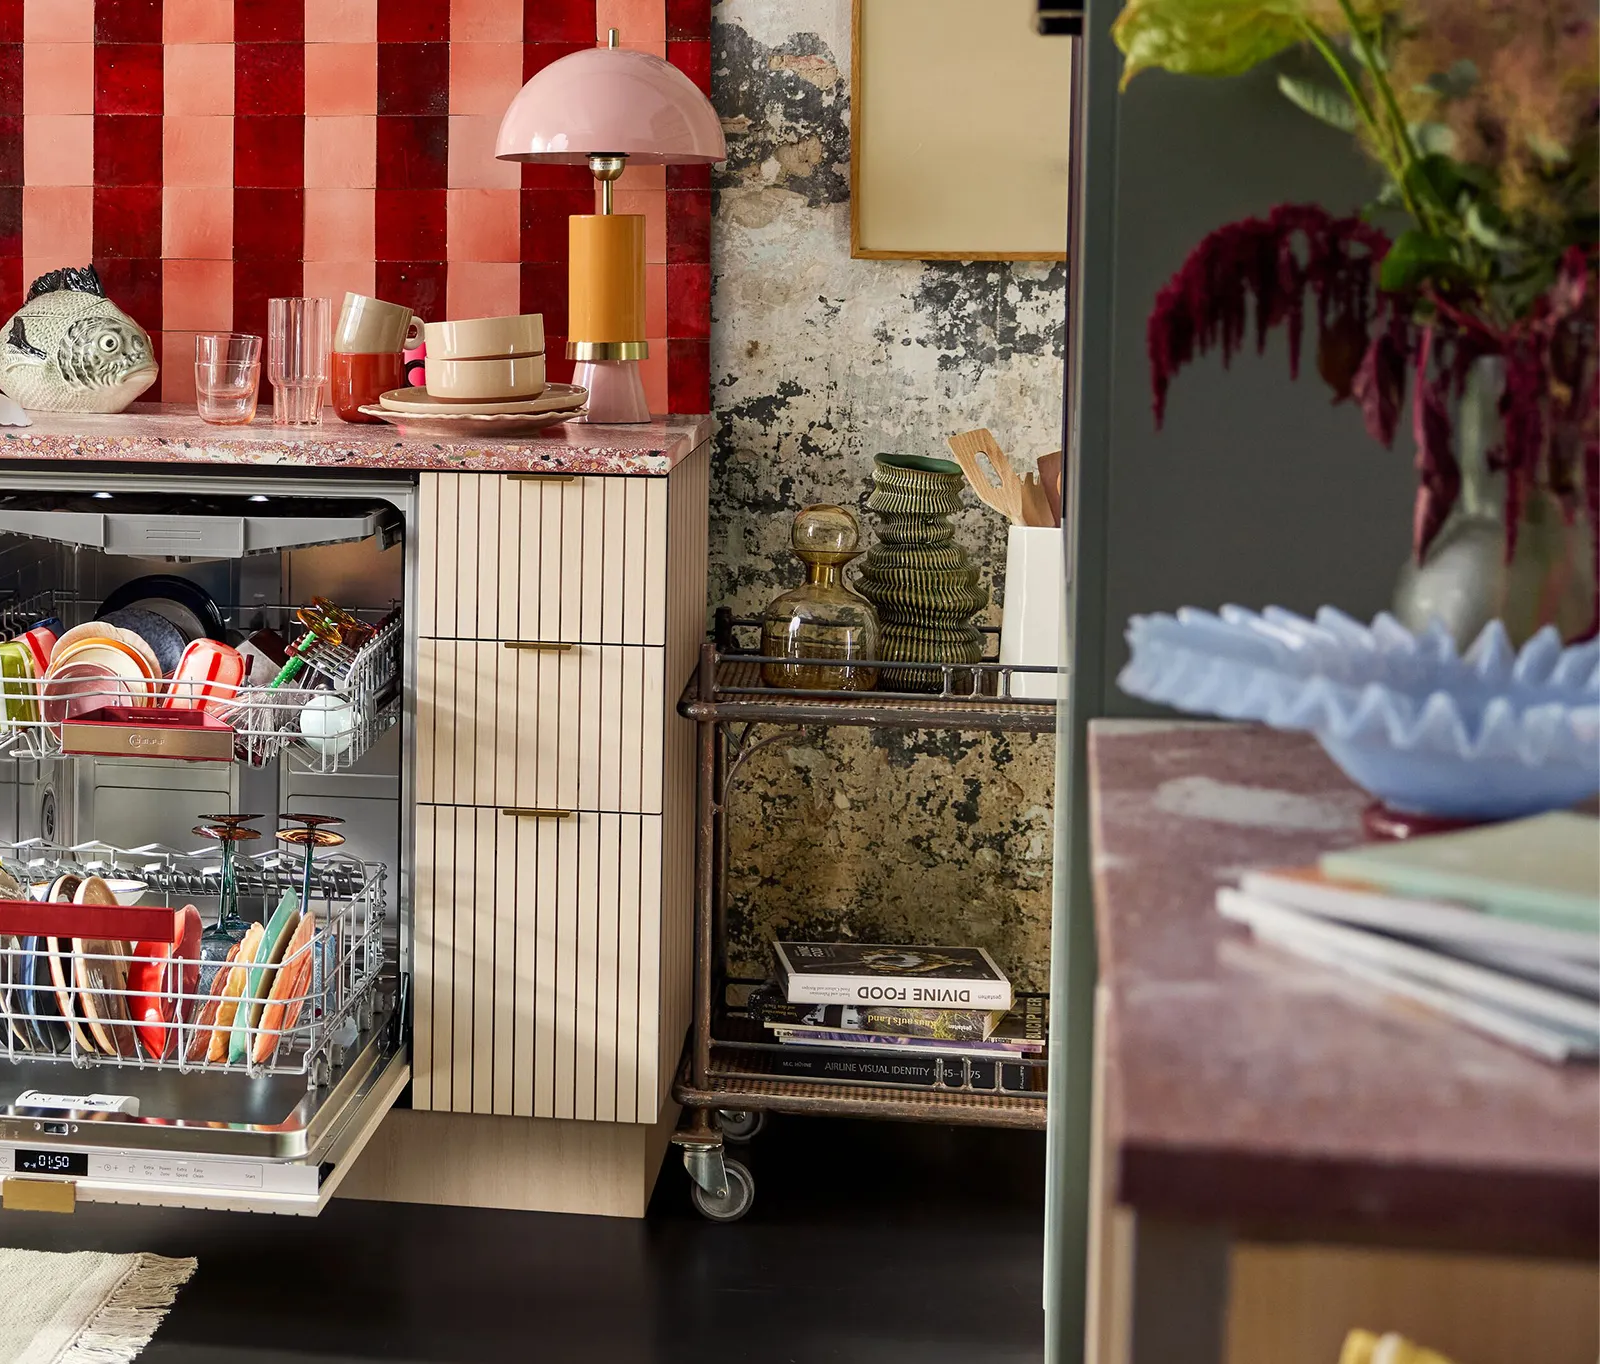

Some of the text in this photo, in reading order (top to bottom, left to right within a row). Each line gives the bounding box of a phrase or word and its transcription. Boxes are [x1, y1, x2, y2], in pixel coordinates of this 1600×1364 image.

[857, 986, 970, 1002] DIVINE FOOD
[867, 1015, 891, 1026] Land
[825, 1062, 857, 1072] AIRLINE
[859, 1064, 889, 1074] VISUAL
[891, 1066, 931, 1076] IDENTITY
[38, 1154, 69, 1168] 01:50
